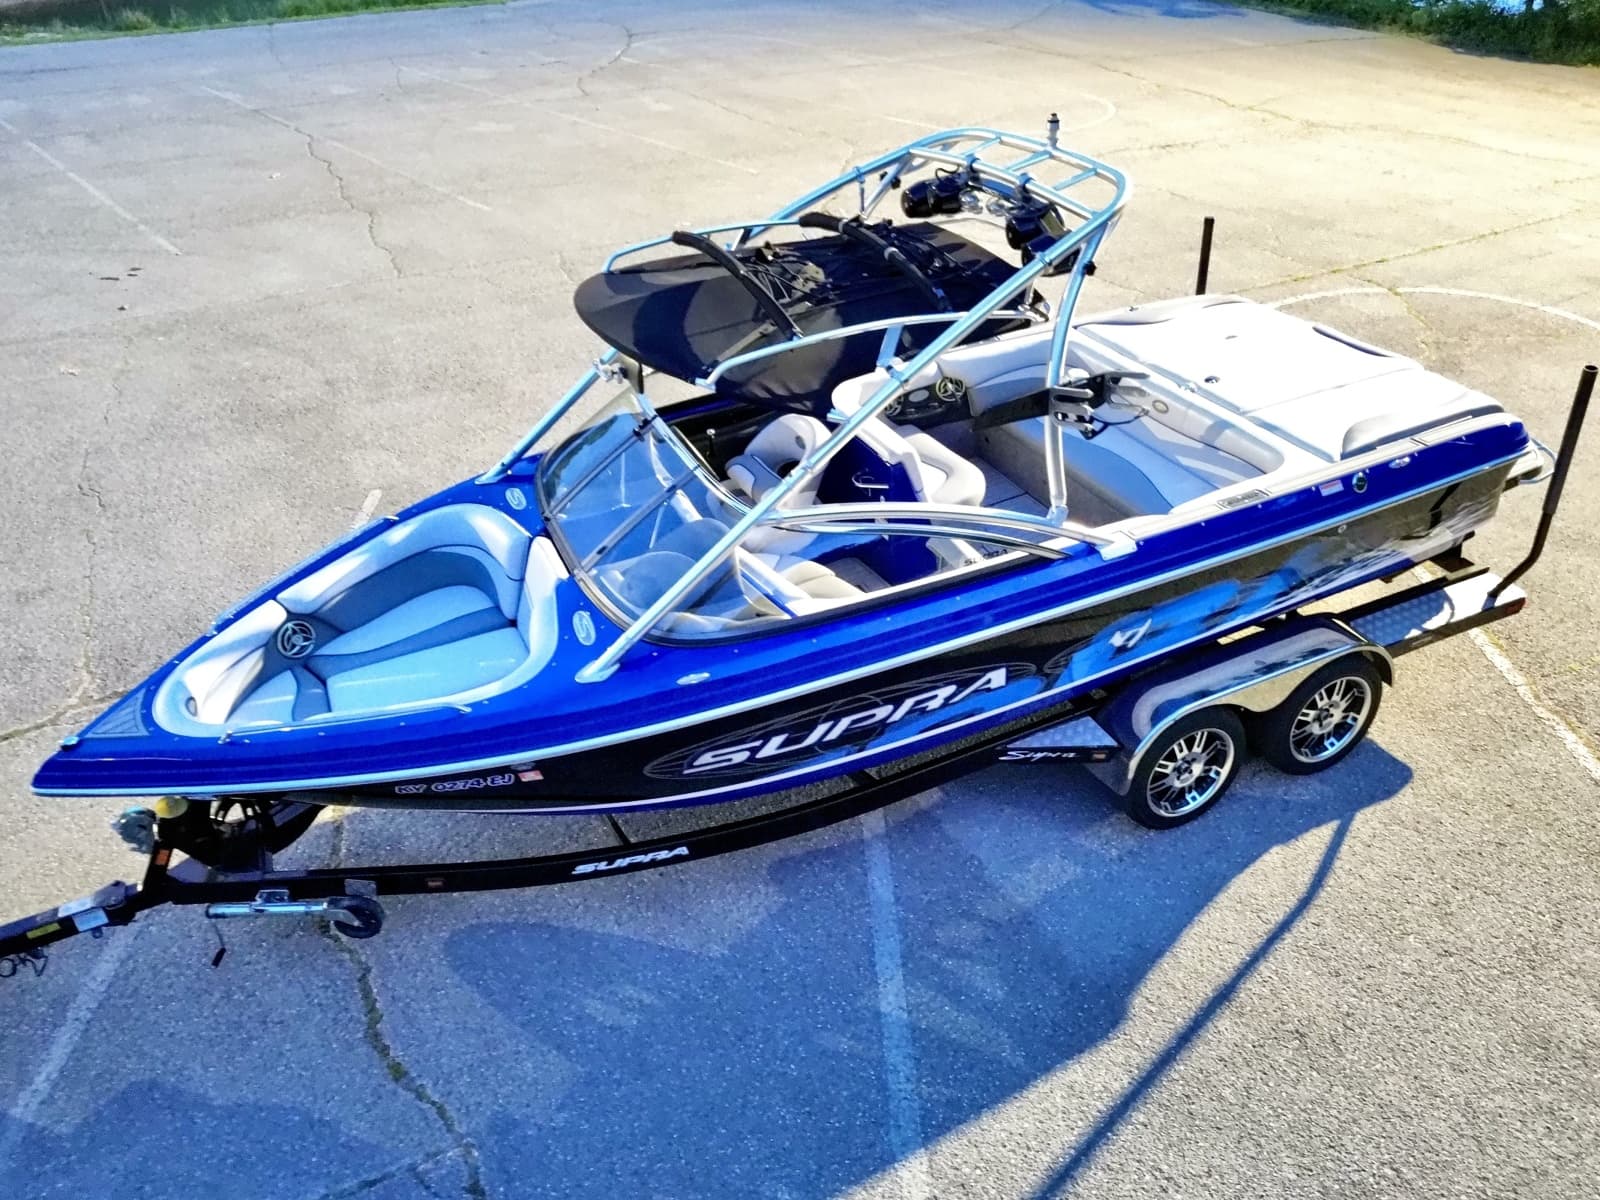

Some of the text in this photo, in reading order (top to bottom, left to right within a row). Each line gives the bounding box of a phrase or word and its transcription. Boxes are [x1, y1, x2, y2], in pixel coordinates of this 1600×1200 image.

[682, 667, 1008, 775] SUPRA
[395, 784, 426, 794] KY
[431, 778, 486, 792] 0274
[487, 773, 515, 787] EJ
[571, 846, 689, 875] SUPRA
